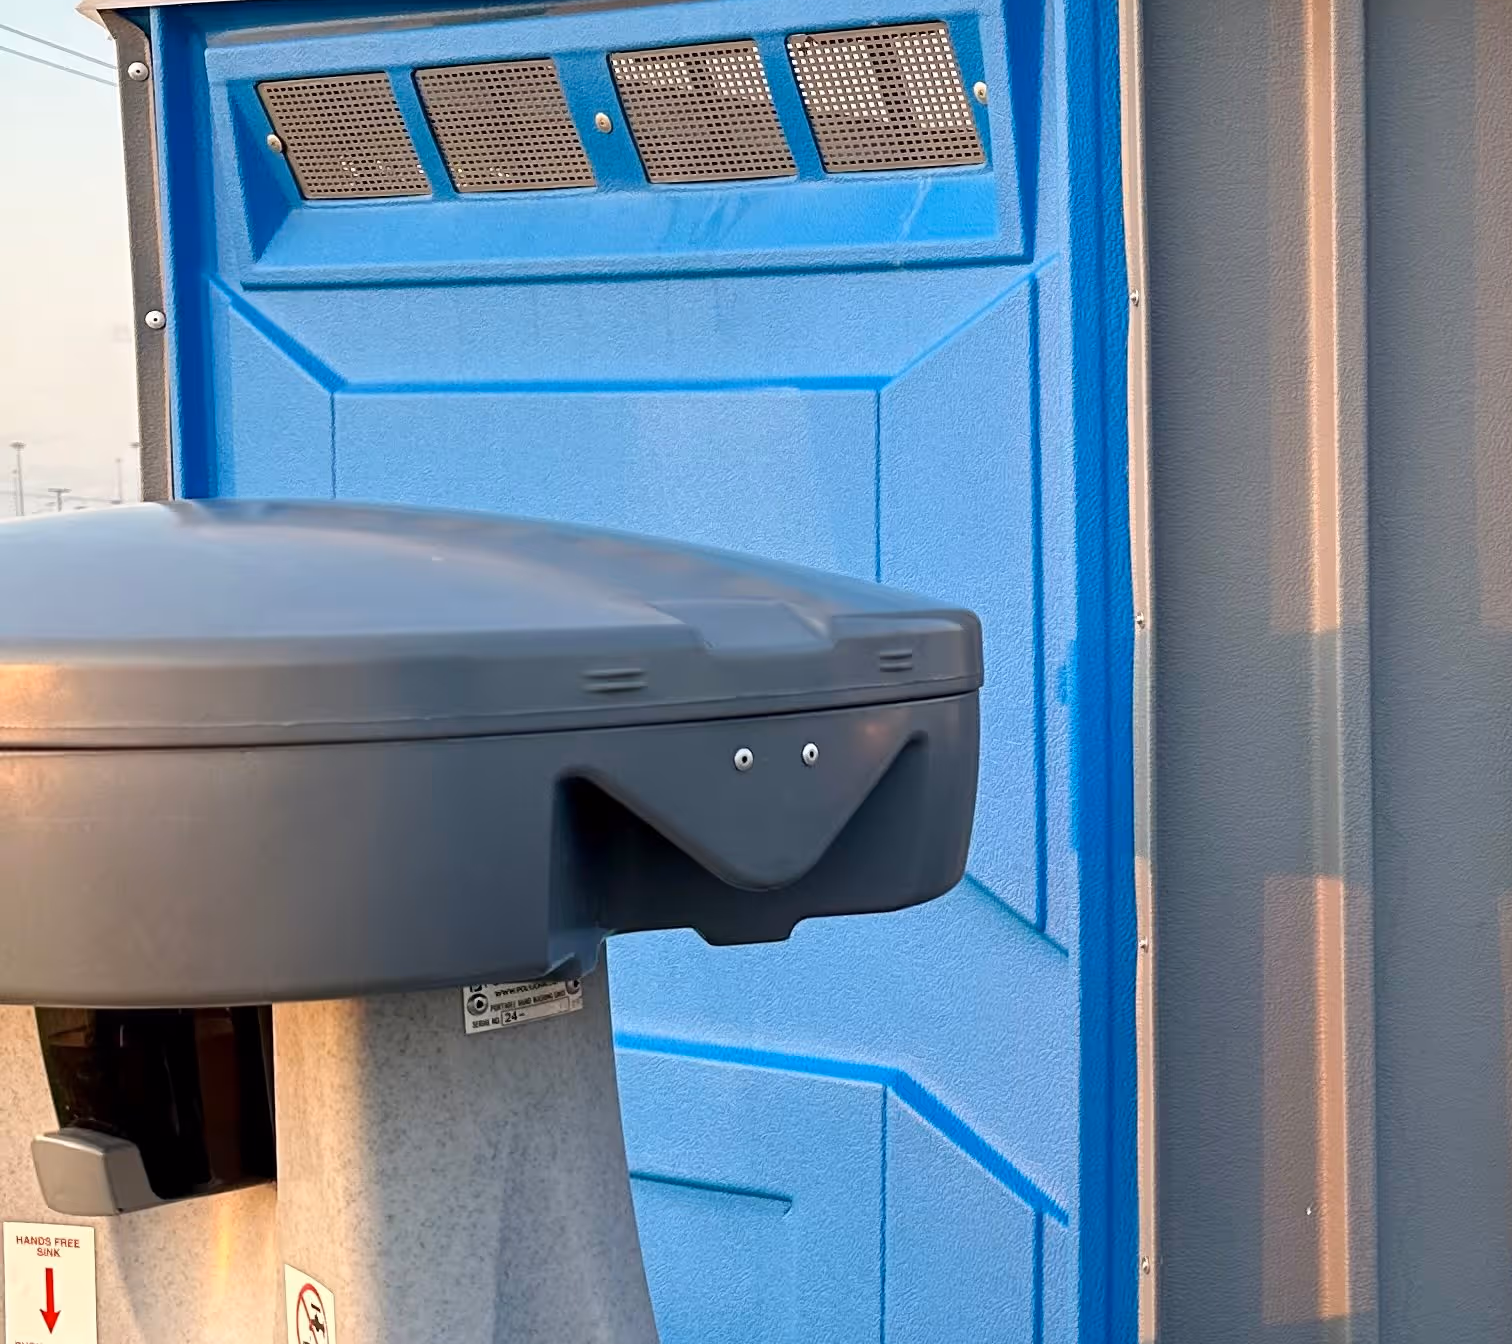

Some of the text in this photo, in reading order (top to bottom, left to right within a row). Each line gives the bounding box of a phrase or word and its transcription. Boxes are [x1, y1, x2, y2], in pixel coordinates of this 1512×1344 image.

[16, 1235, 80, 1248] HANDS FREE
[37, 1247, 61, 1257] SINK
